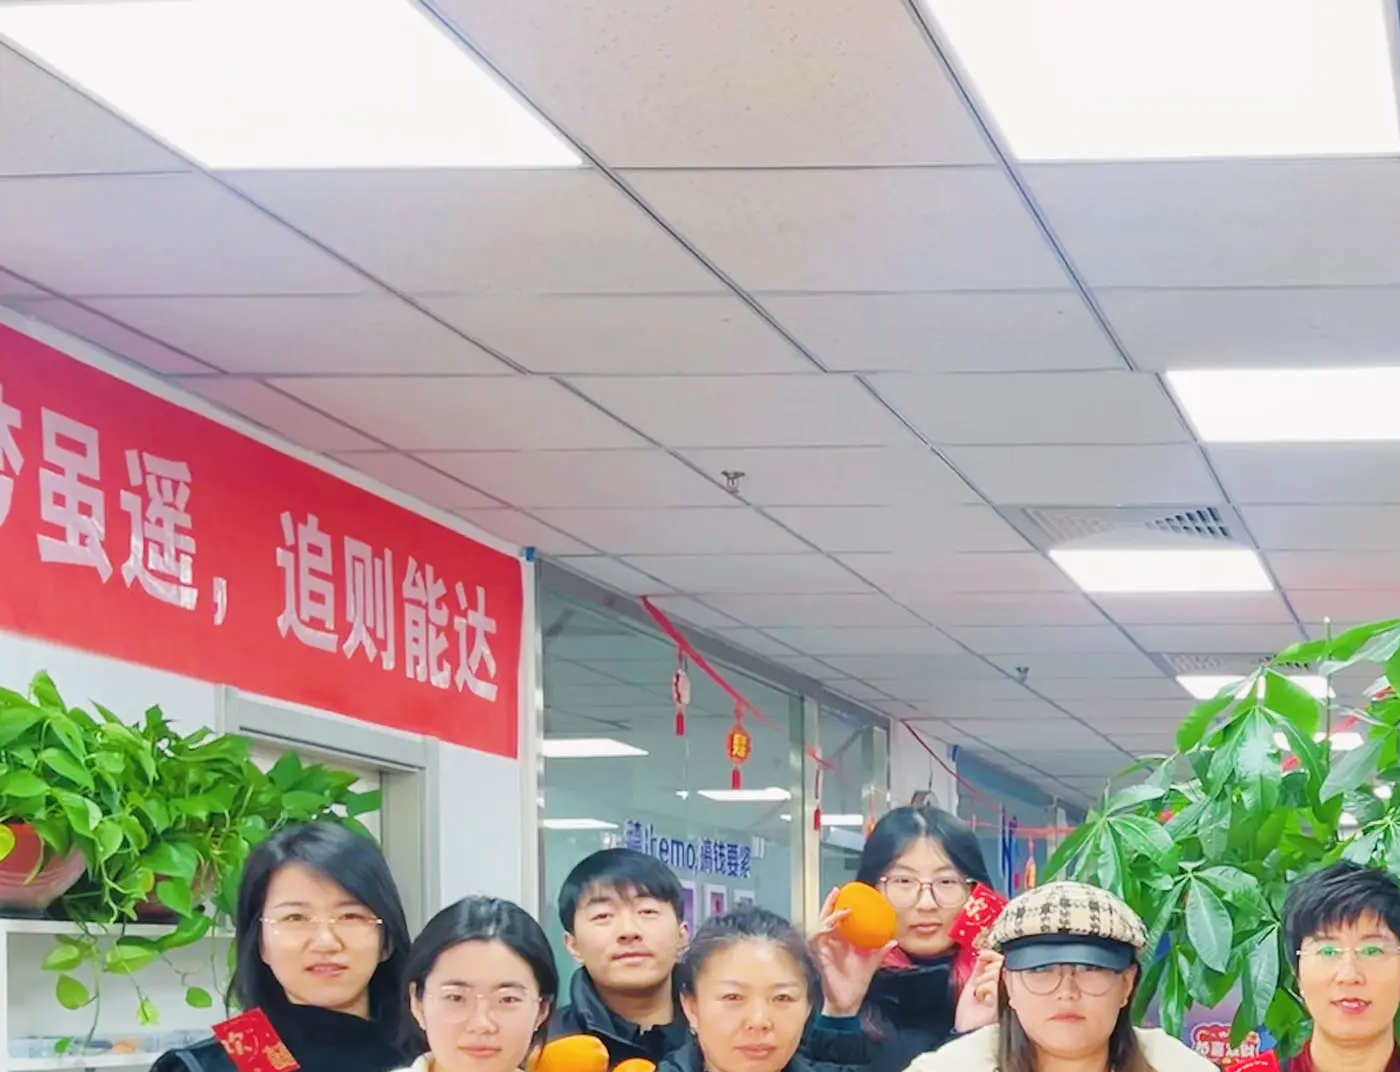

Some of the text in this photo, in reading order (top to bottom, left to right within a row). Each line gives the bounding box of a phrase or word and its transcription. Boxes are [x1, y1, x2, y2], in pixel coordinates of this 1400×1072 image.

[0, 383, 498, 702] 虽遥，追则能达
